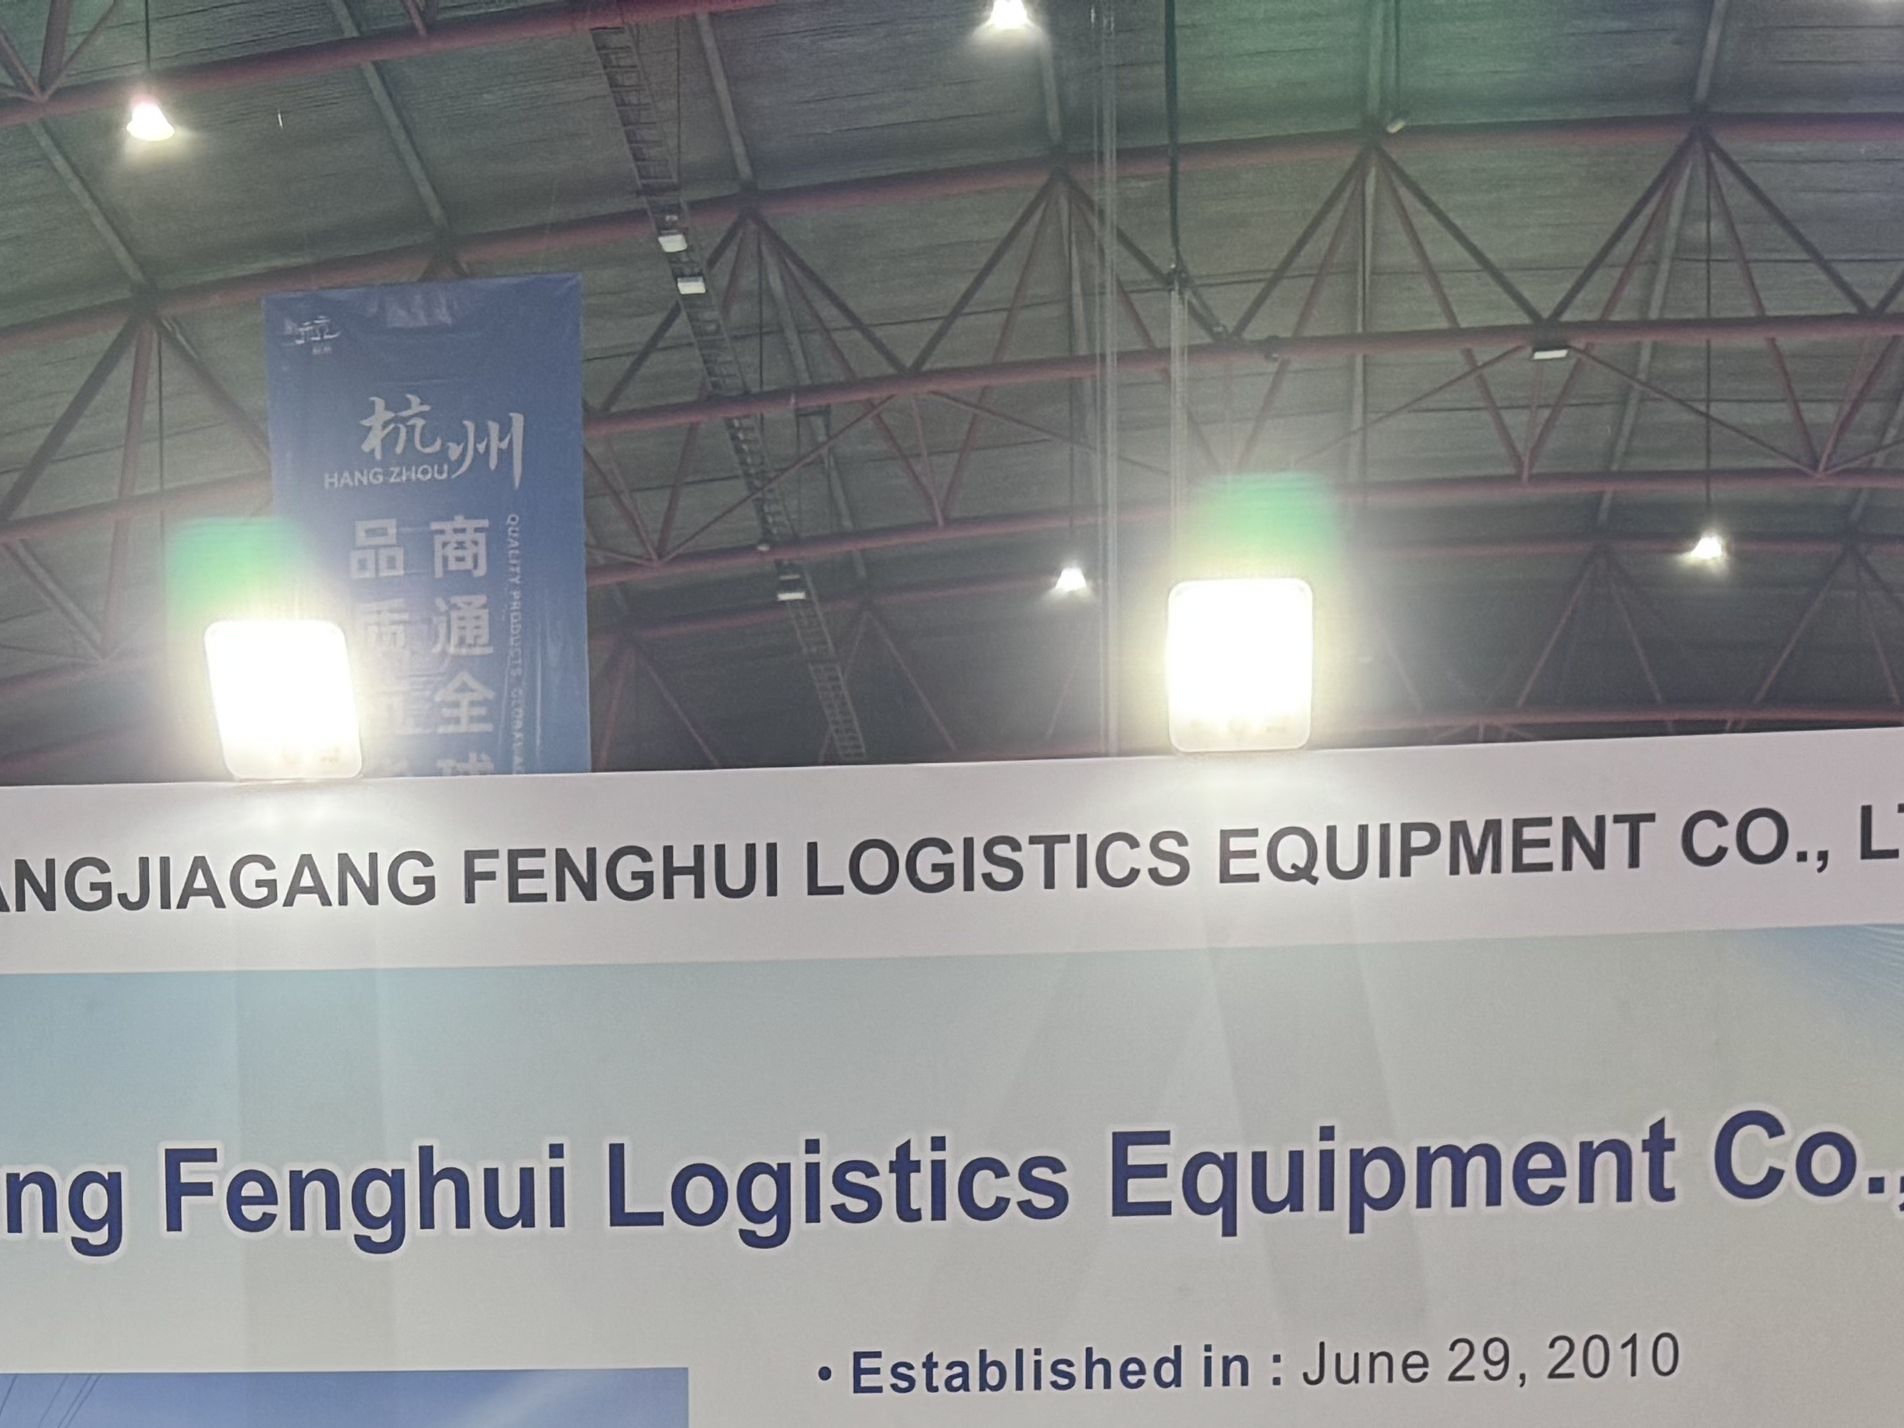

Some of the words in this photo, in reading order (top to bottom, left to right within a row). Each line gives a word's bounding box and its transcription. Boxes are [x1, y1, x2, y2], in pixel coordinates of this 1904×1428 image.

[324, 467, 384, 489] HANG
[389, 463, 449, 484] ZHOU
[359, 394, 526, 490] 杭州
[506, 513, 520, 584] QUALITY
[462, 841, 779, 904] FENGHUI
[805, 828, 1191, 897] LOGISTICS
[1217, 811, 1655, 886] EQUIPMENT
[1678, 804, 1832, 874] CO.,
[162, 1141, 566, 1254] Fenghui
[607, 1134, 1071, 1249] Logistics
[1108, 1116, 1678, 1238] Equipment
[852, 1344, 1184, 1394] Established
[1202, 1344, 1251, 1388] in
[1302, 1338, 1430, 1387] June
[1447, 1336, 1529, 1387] 29,
[1546, 1331, 1681, 1381] 2010
